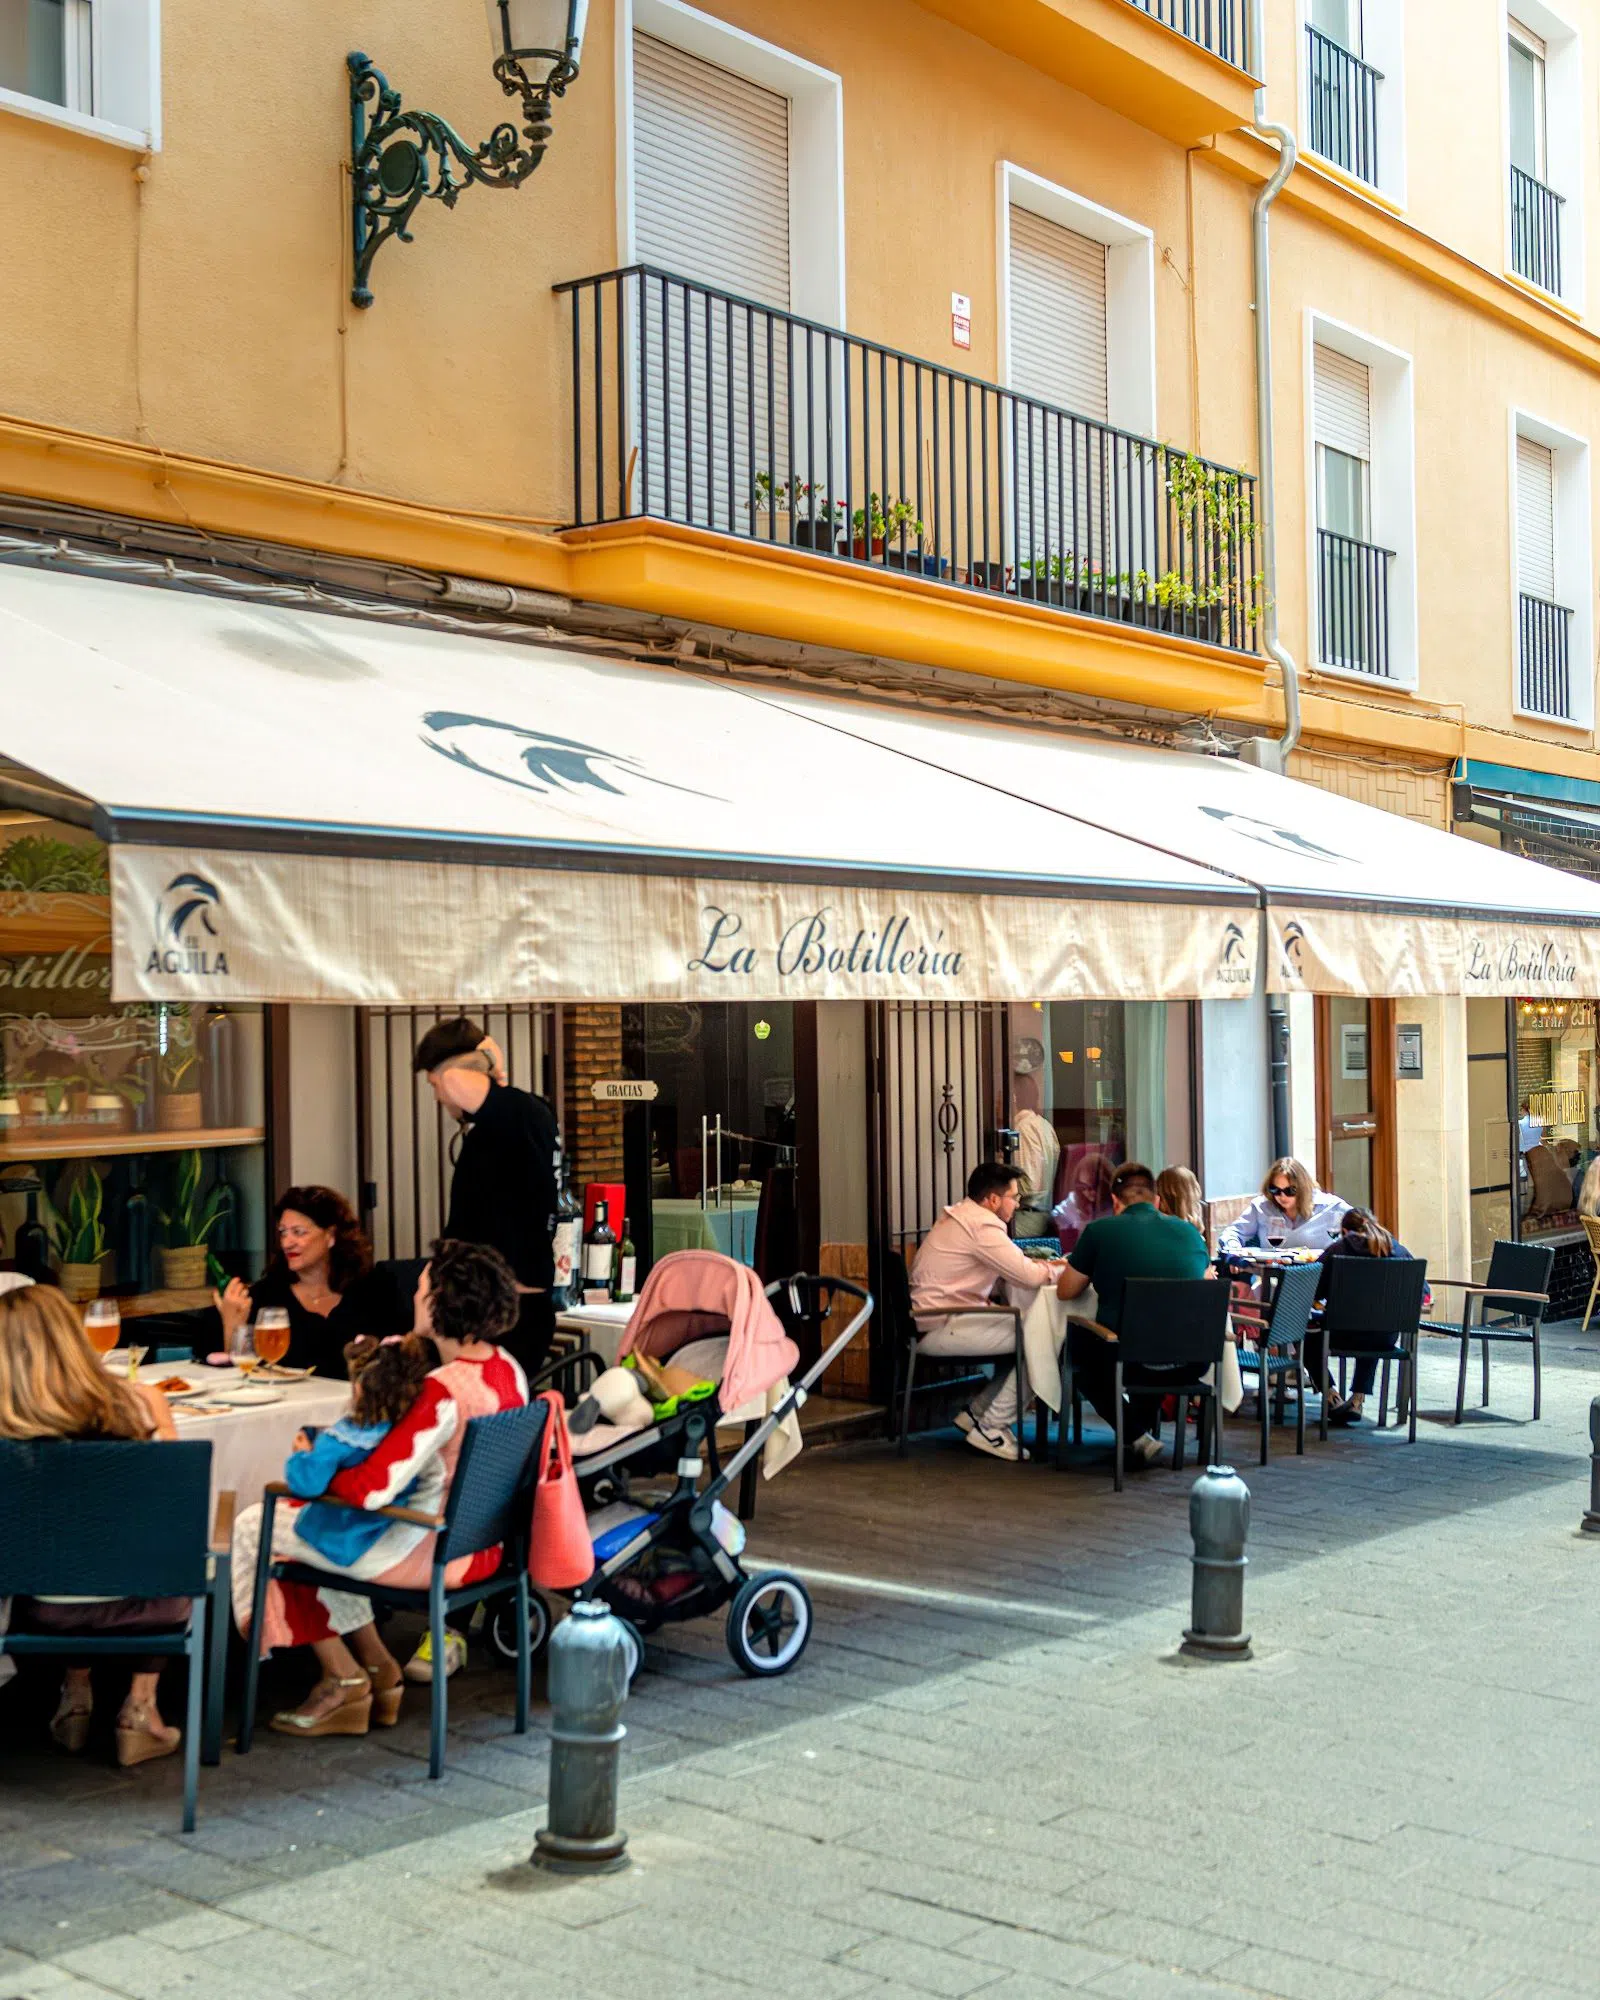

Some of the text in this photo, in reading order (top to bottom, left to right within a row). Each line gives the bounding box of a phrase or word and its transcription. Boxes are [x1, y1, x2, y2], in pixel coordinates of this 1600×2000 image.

[687, 905, 964, 976] La Botillería
[1464, 938, 1491, 980] La
[606, 1084, 643, 1097] GRACIAS
